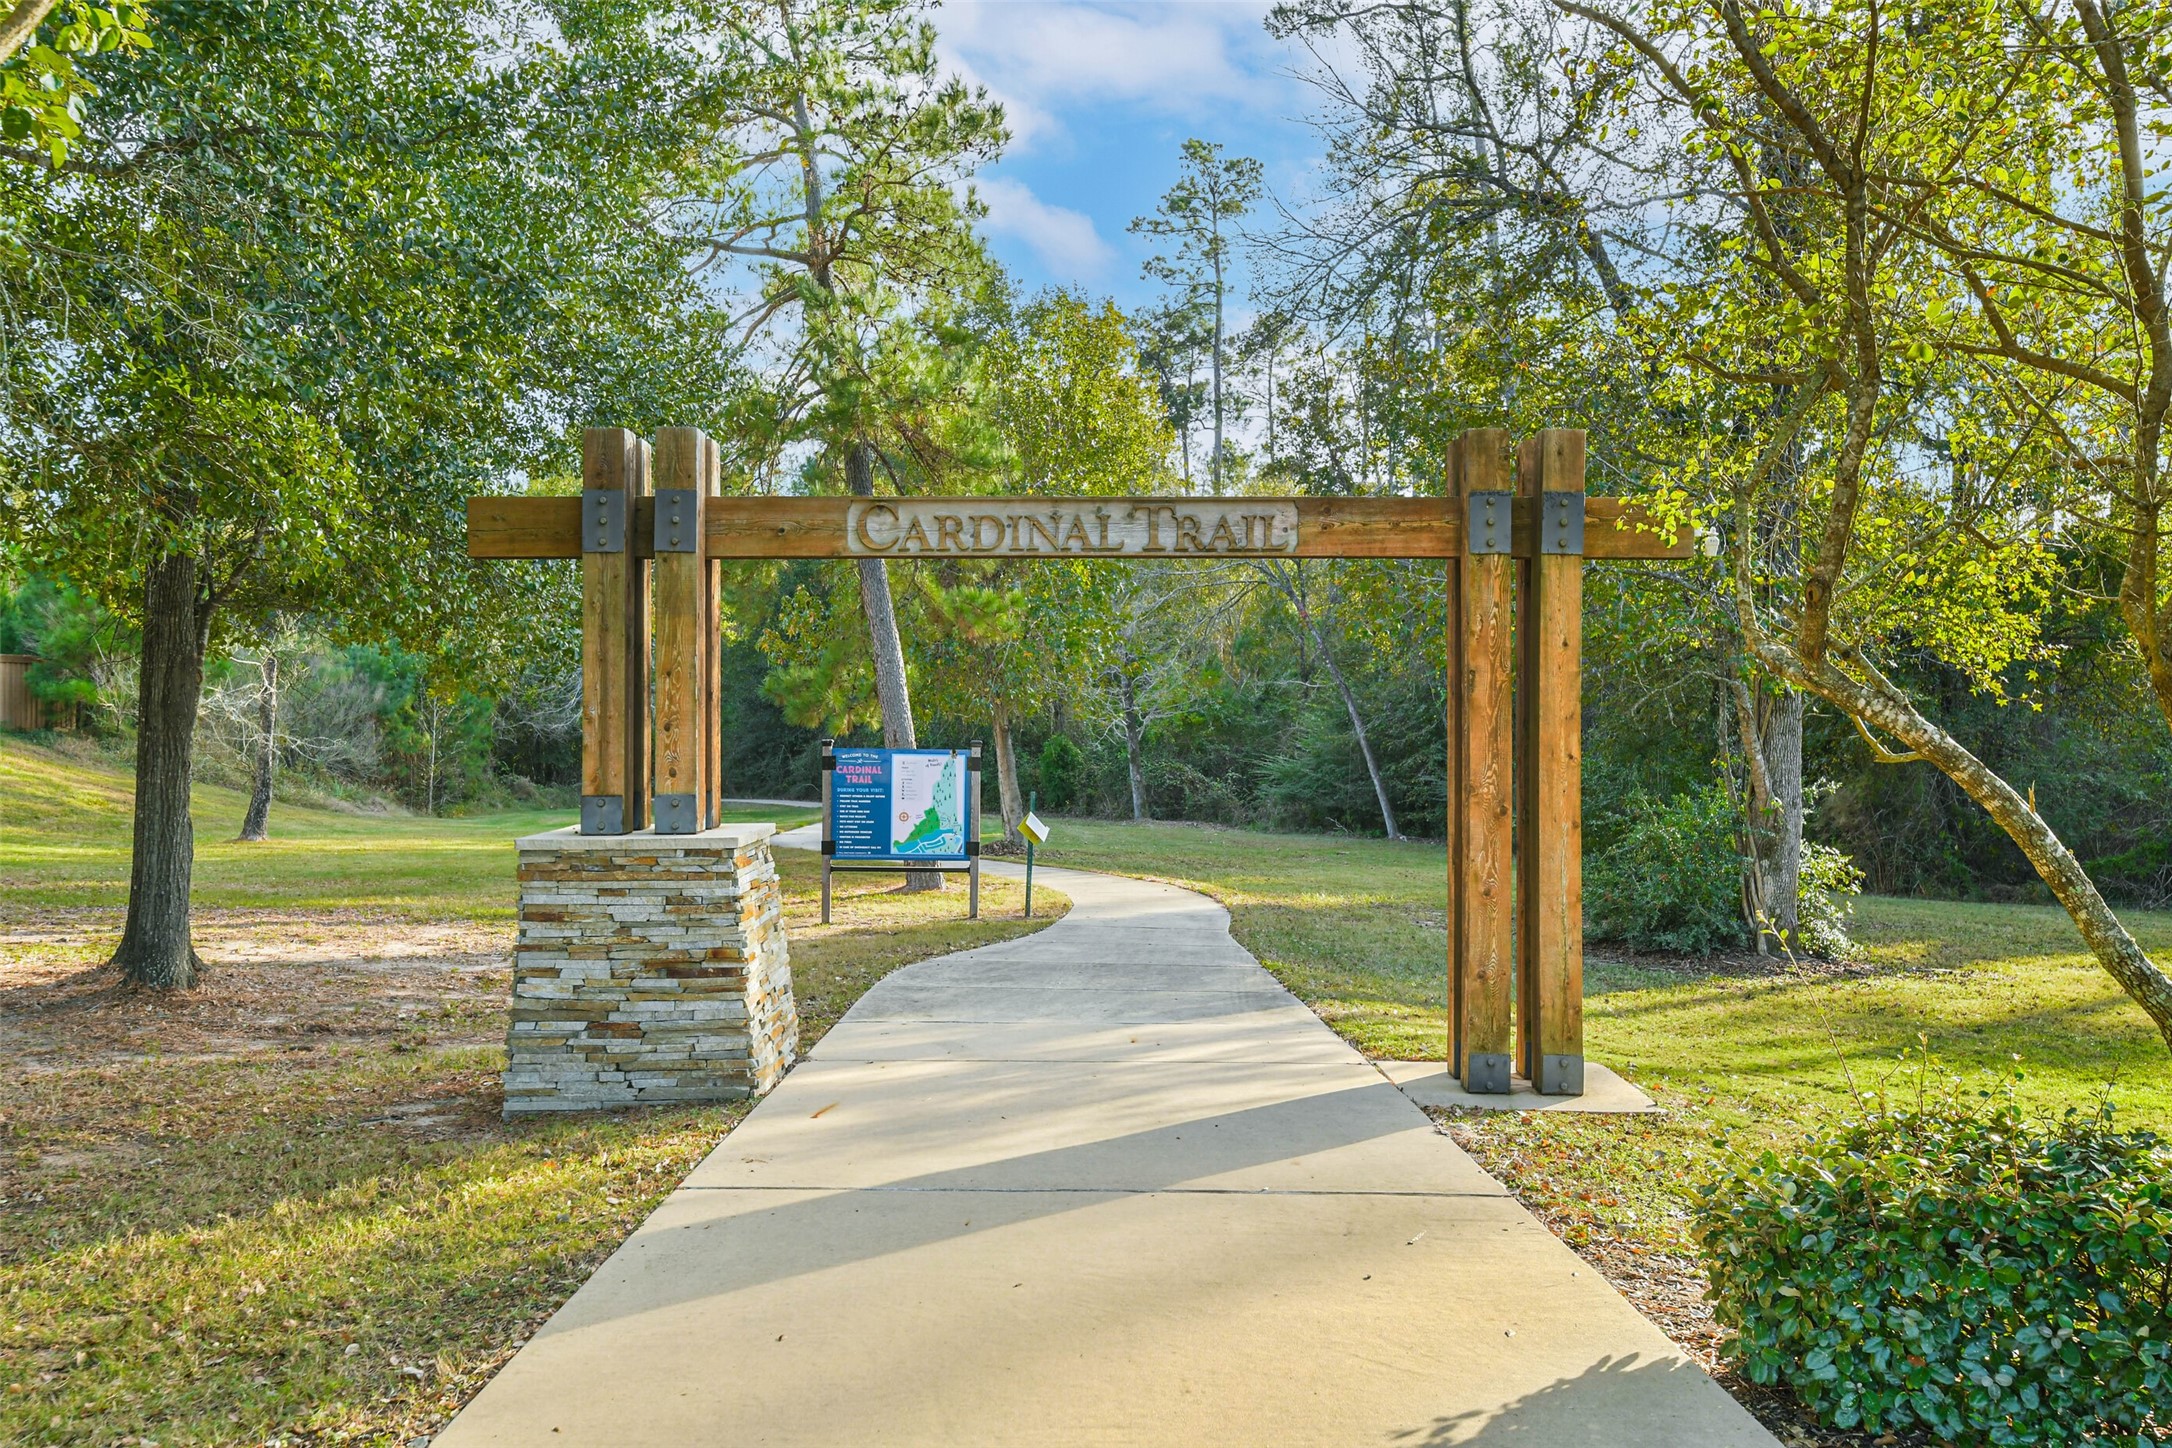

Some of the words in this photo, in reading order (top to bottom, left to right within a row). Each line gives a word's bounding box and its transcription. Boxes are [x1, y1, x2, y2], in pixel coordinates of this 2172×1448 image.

[855, 502, 1126, 553] CARDINAL
[1134, 503, 1289, 553] TRAIL
[836, 765, 882, 774] CARDINAL
[845, 775, 873, 784] TRAIL
